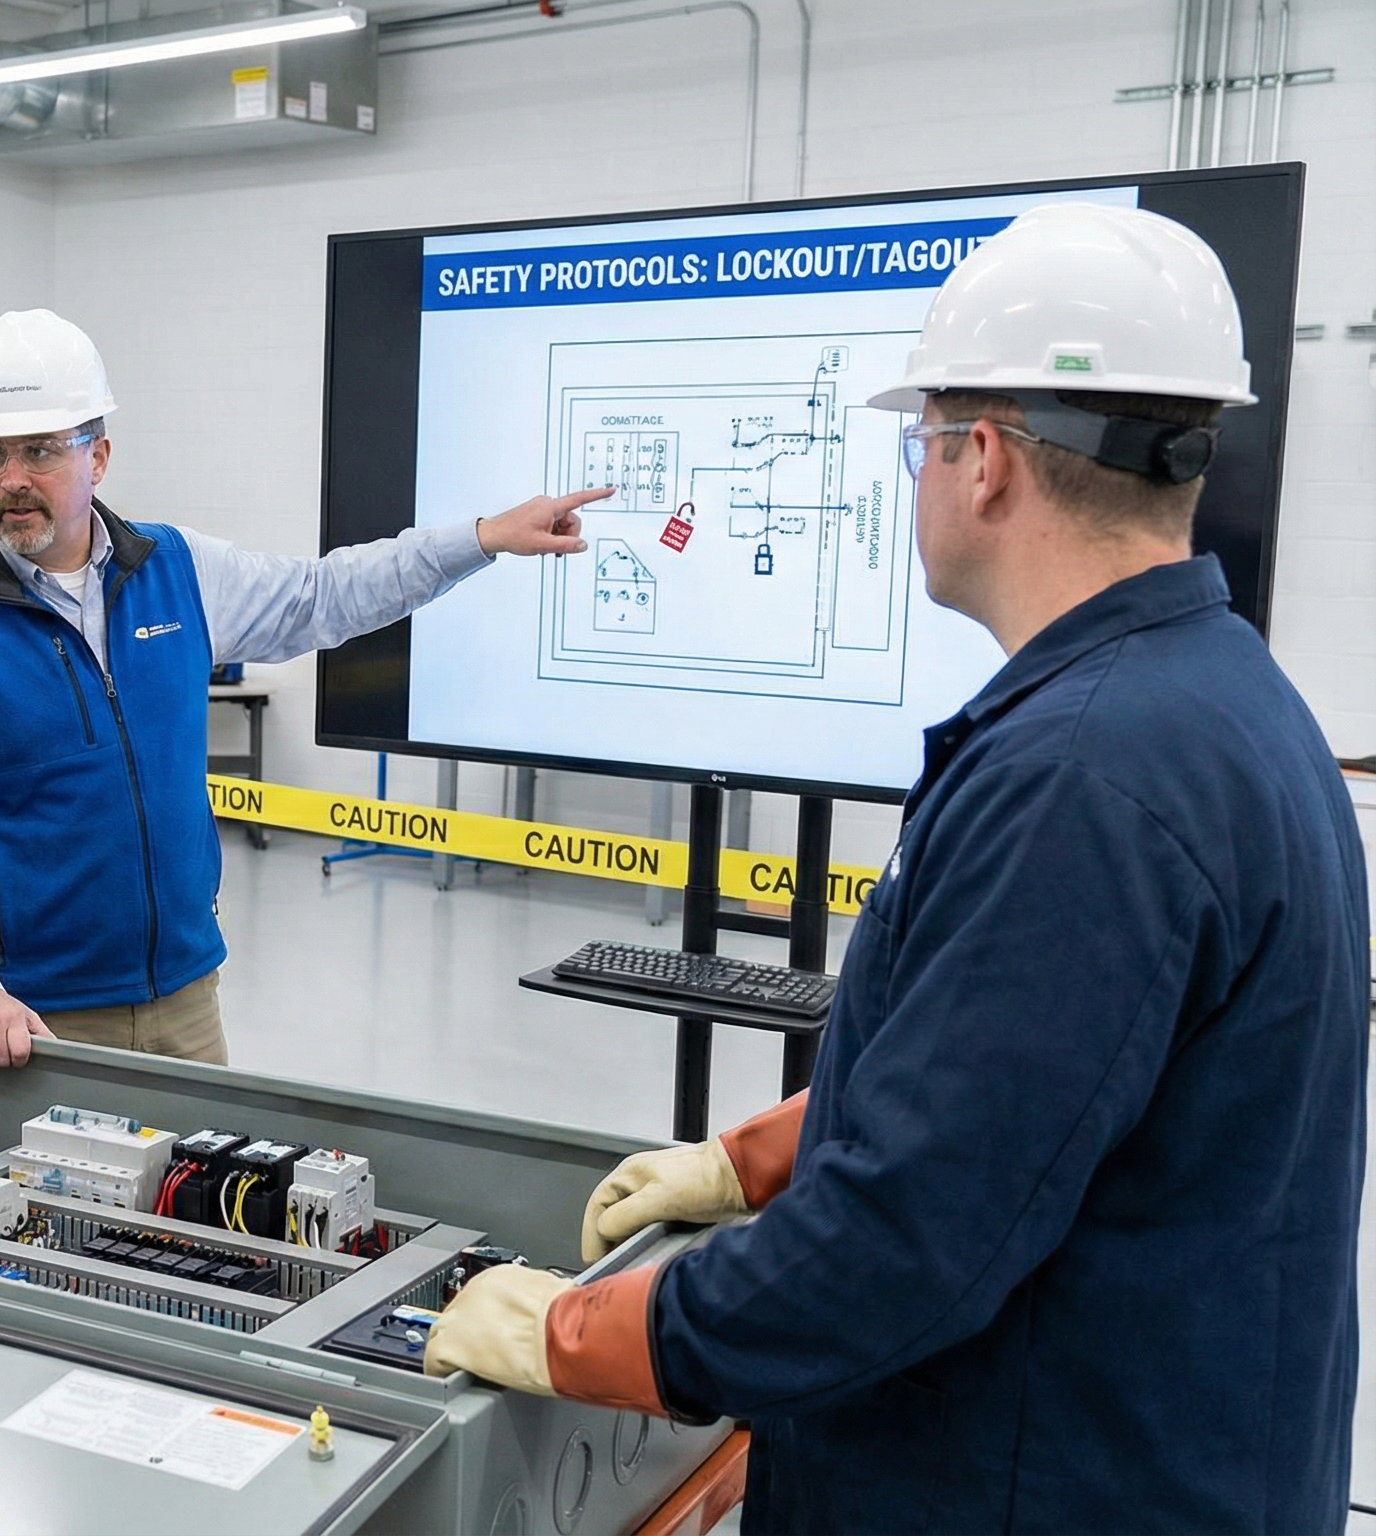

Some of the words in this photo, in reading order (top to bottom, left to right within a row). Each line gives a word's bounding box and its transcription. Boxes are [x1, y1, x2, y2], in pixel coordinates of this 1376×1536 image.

[438, 263, 530, 296] SAFETY
[540, 253, 708, 292] PROTOCOLS:
[208, 783, 263, 814] TION
[330, 802, 447, 843] CAUTION
[525, 831, 659, 875] CAUTION
[750, 862, 877, 906] CATIO
